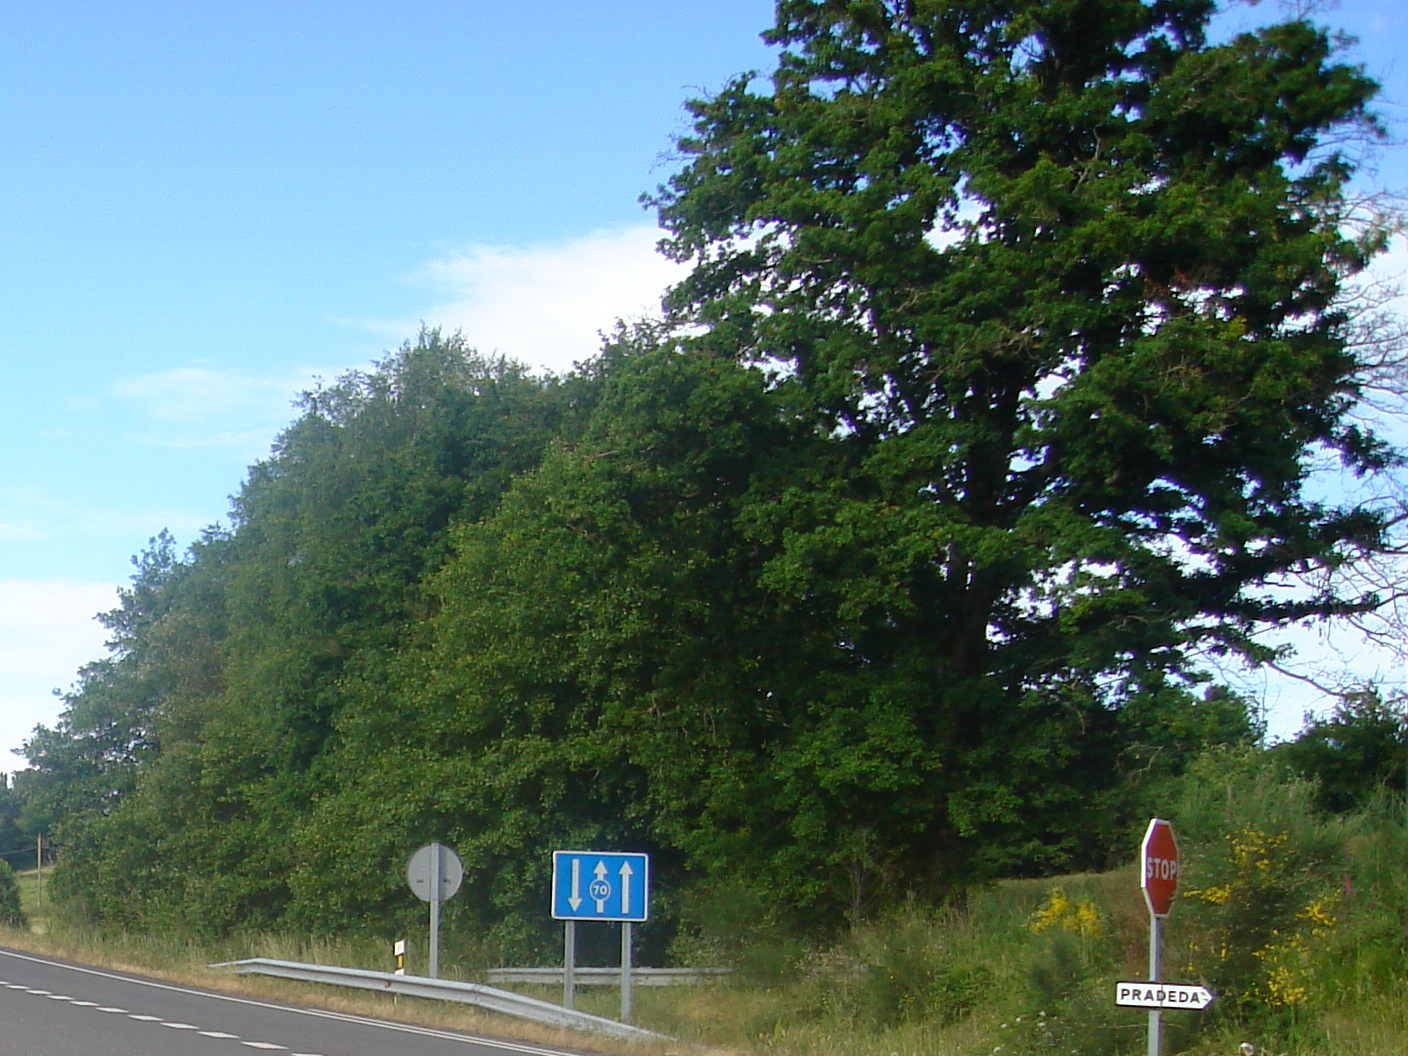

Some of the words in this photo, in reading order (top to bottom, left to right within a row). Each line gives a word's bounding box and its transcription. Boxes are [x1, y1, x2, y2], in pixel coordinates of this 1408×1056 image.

[1146, 857, 1178, 880] STOP
[593, 885, 608, 895] 70
[1120, 988, 1201, 1004] PRADEDA
